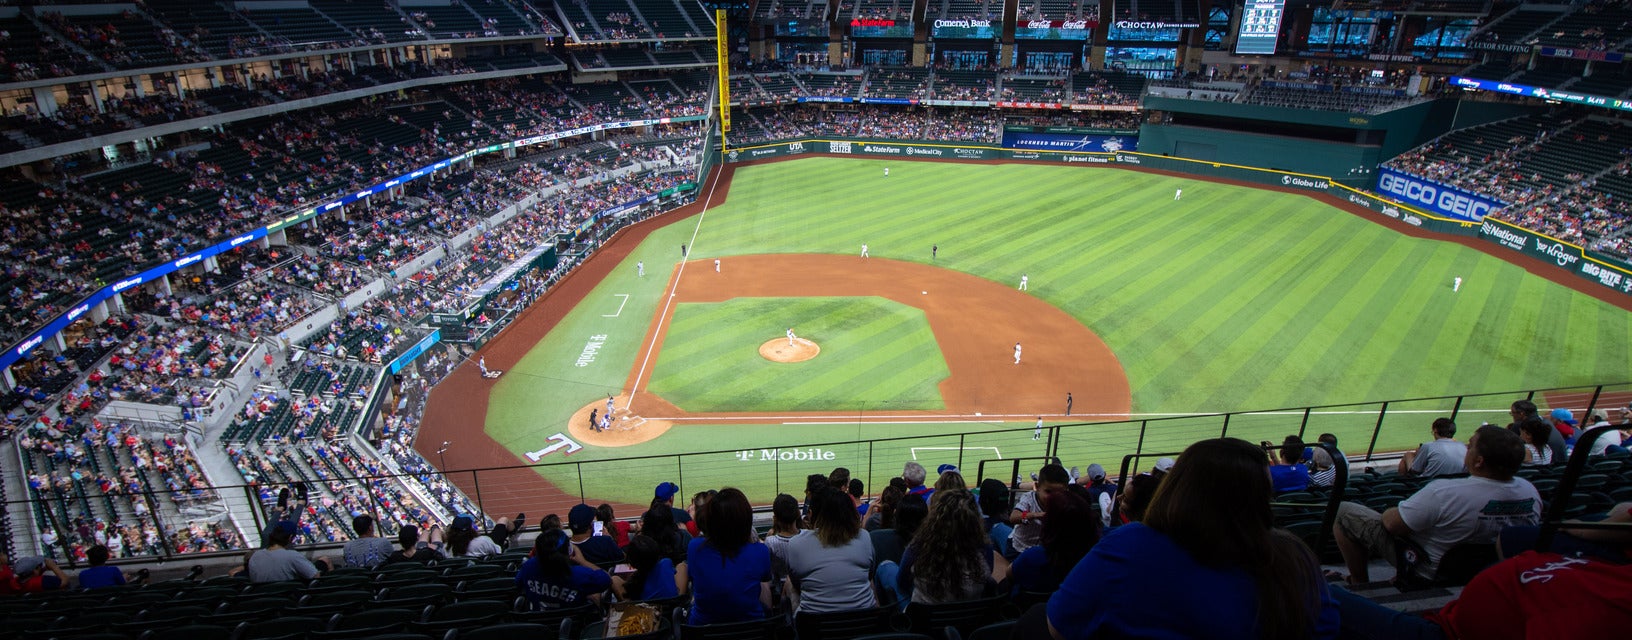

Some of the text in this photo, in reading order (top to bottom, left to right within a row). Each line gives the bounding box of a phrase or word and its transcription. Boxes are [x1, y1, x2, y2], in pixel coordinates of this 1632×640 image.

[970, 19, 991, 28] Bank
[1121, 21, 1164, 29] CHOCTAW
[1474, 41, 1530, 53] LUXOR STAFFING
[1554, 48, 1574, 58] 105.3
[789, 142, 804, 151] UTA
[1016, 139, 1048, 147] LOCKHEED
[830, 145, 852, 154] SELTZER
[932, 149, 943, 157] City
[1292, 178, 1314, 188] Globe
[1314, 180, 1329, 190] Life
[1379, 173, 1437, 205] GEICO
[1489, 225, 1527, 246] National
[1546, 243, 1578, 266] Kroger
[1598, 268, 1623, 285] BITE
[575, 341, 604, 367] Mobile
[522, 431, 584, 464] T
[759, 448, 835, 461] Mobile
[527, 579, 578, 603] SEAGER
